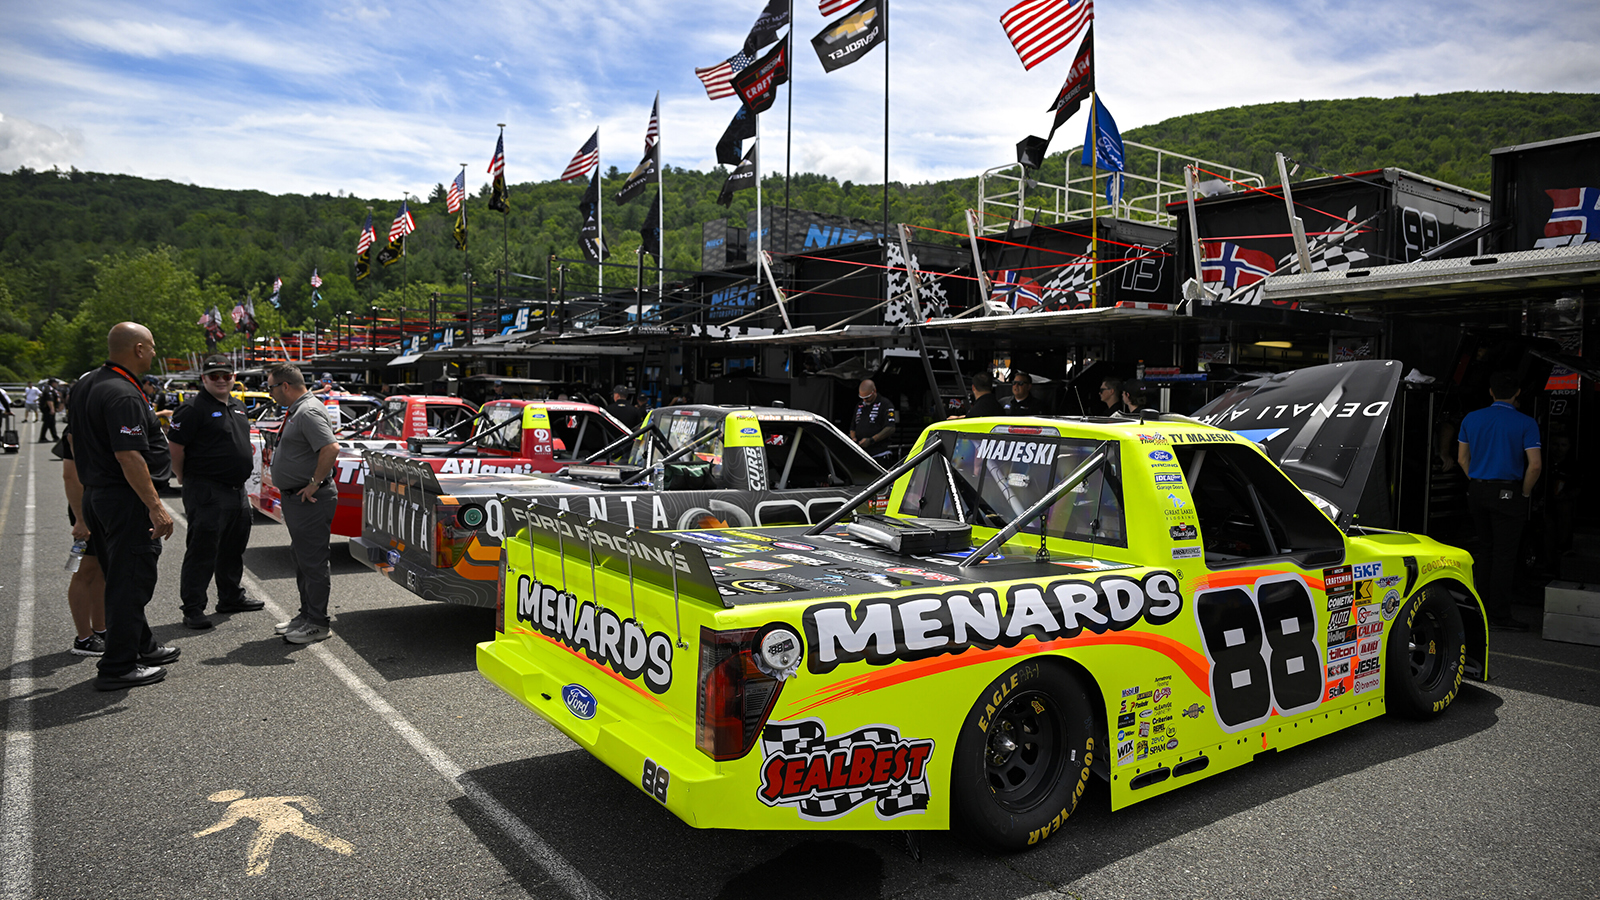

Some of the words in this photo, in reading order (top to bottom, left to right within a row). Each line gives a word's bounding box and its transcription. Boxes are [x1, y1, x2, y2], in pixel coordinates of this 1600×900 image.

[1121, 243, 1165, 292] 13
[515, 307, 530, 332] 45
[1257, 401, 1389, 419] DENALI
[670, 420, 698, 435] GARCIA
[1169, 433, 1185, 443] TY
[1187, 433, 1236, 443] MAJESKI
[977, 439, 1057, 465] MAJESKI
[1151, 450, 1171, 461] Ford
[746, 447, 761, 491] CURB
[367, 488, 429, 552] QUANTA
[512, 508, 574, 538] FORD
[578, 525, 693, 574] RACING
[1325, 575, 1351, 586] CRAFTSMAN
[1354, 563, 1381, 579] SKF
[1328, 594, 1354, 608] COMETIC
[1407, 590, 1426, 629] EAGLE
[808, 573, 1182, 668] MENARDS
[1331, 611, 1350, 625] KLOTZ
[518, 575, 673, 690] MENARDS
[1328, 630, 1346, 642] Holley
[1358, 622, 1384, 637] CALICO
[1195, 575, 1324, 731] 88
[1329, 646, 1355, 660] tilton
[1355, 656, 1381, 674] JESEL
[1361, 679, 1380, 690] brembo
[1433, 644, 1467, 712] GOODYEAR
[563, 686, 594, 718] Ford
[978, 672, 1019, 733] EAGLE
[1152, 715, 1172, 724] Criterion
[1118, 739, 1133, 758] WIX
[1150, 743, 1166, 755] SPAM
[641, 757, 670, 804] 88
[764, 744, 932, 798] SEALBEST
[1027, 737, 1095, 845] GOODYEAR
